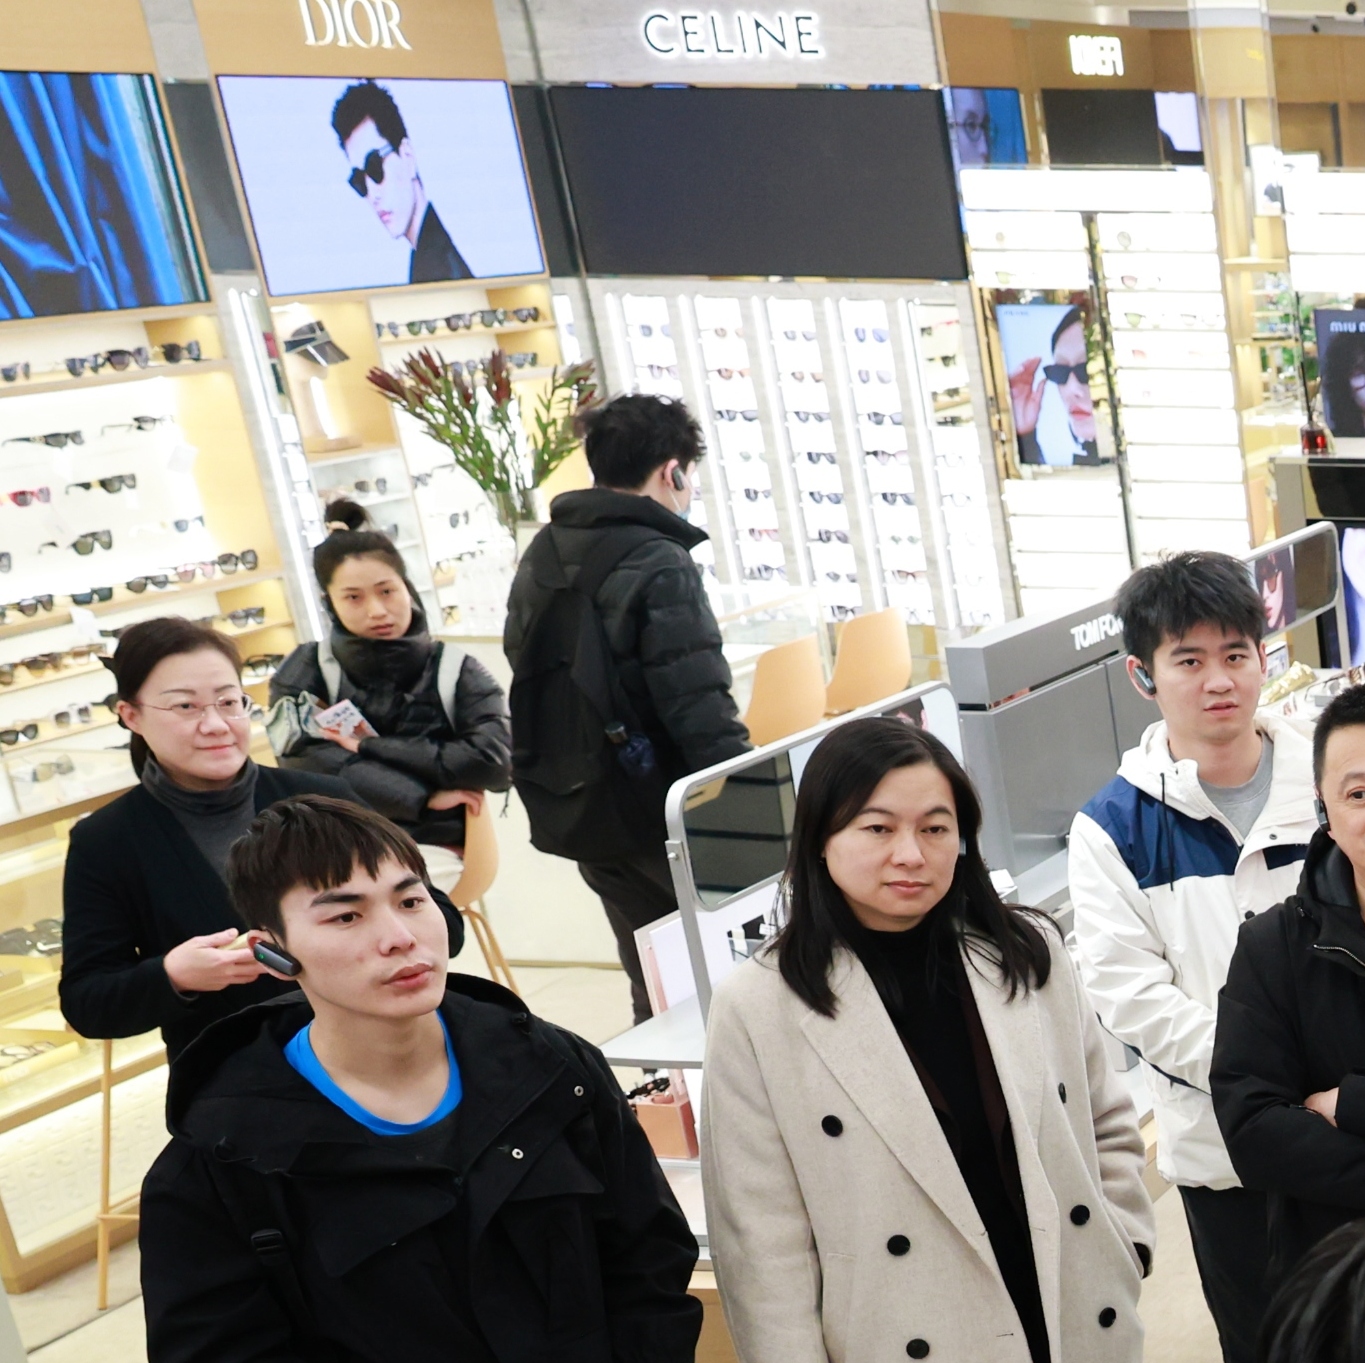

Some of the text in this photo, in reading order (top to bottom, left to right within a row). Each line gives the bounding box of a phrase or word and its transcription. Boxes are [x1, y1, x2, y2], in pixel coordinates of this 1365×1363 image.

[299, 0, 413, 50] DIOR
[644, 14, 819, 54] CELINE
[1070, 619, 1101, 651] TOM
